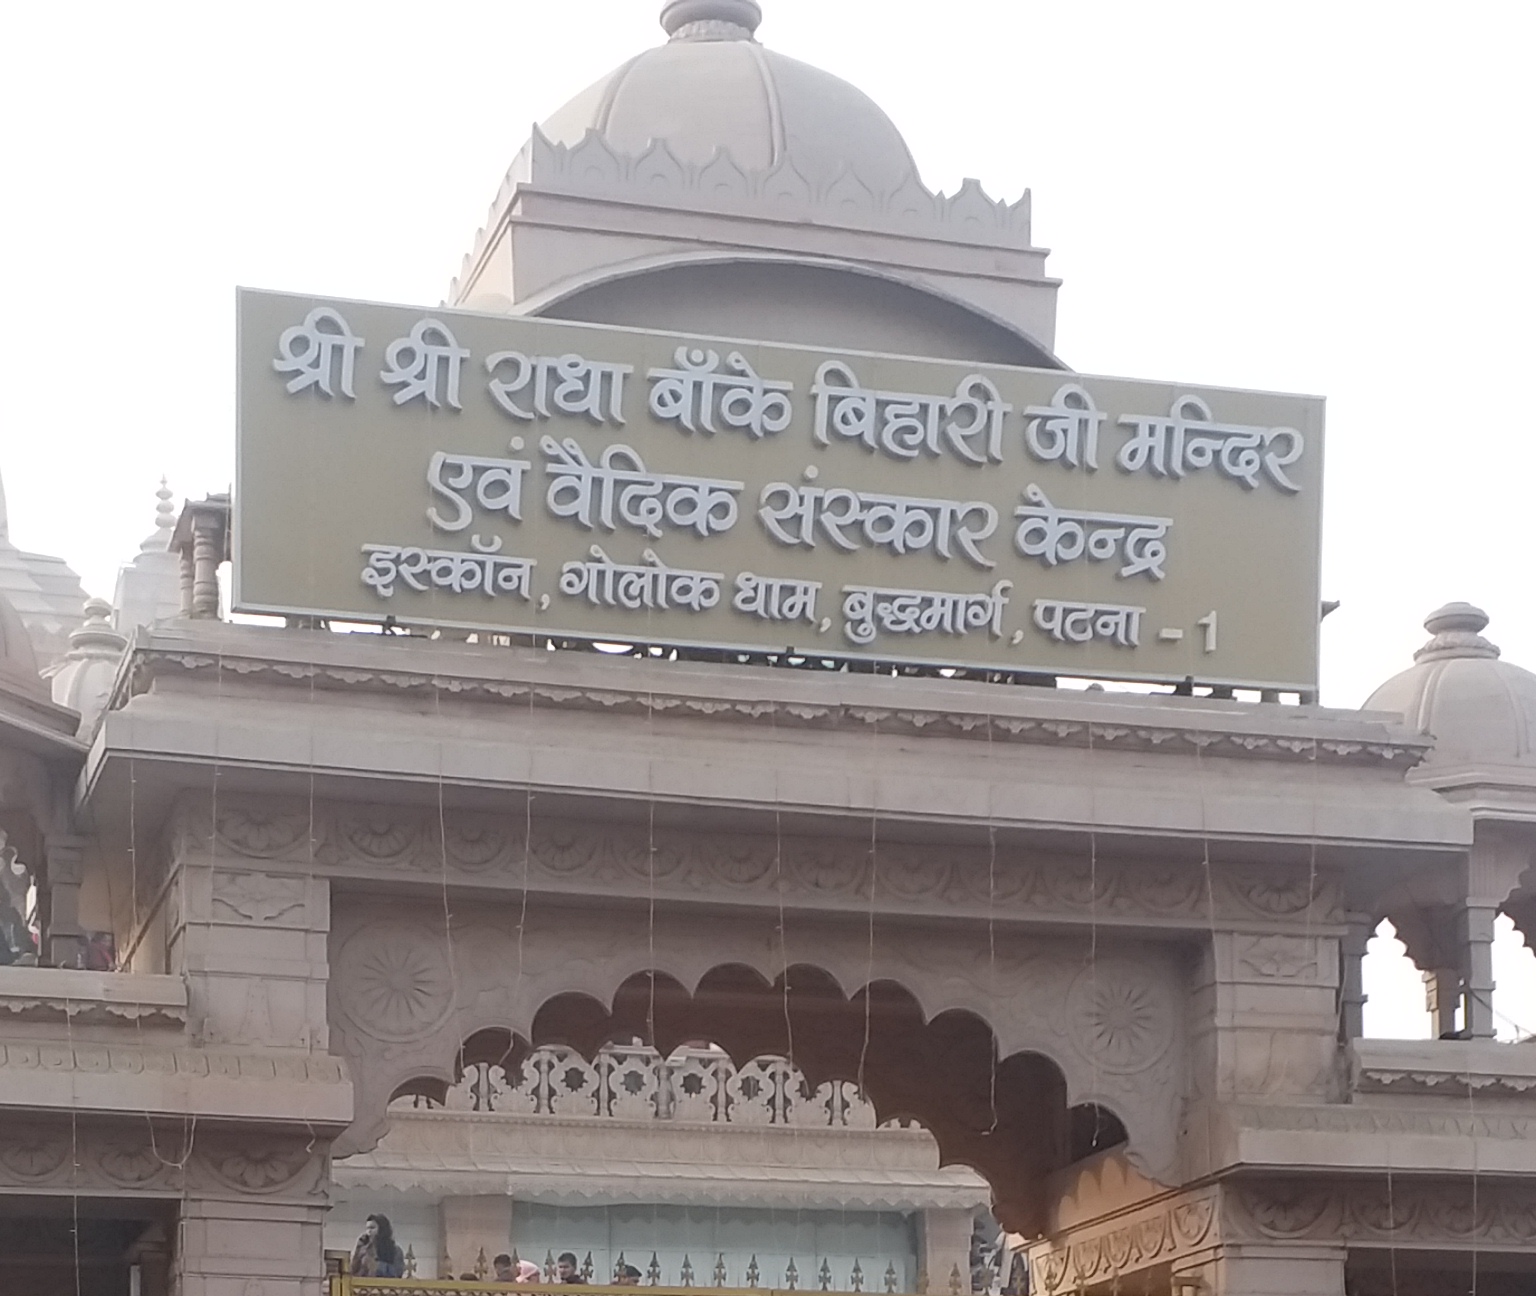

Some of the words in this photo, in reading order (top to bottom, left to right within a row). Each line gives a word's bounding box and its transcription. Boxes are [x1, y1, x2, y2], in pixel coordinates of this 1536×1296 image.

[273, 307, 364, 398] श्री
[380, 319, 470, 410] श्री
[485, 351, 634, 424] राधा
[646, 346, 794, 438] बाँके
[811, 360, 1013, 463] बिहारी
[1024, 384, 1107, 471] जी
[1117, 394, 1304, 492] मन्दिर
[426, 436, 531, 531] एवं
[539, 434, 744, 538] वैदिक
[758, 465, 999, 568] संस्कार
[1014, 483, 1173, 580] केन्द्र
[560, 544, 724, 611] गोलोक
[1033, 598, 1146, 646] पटना
